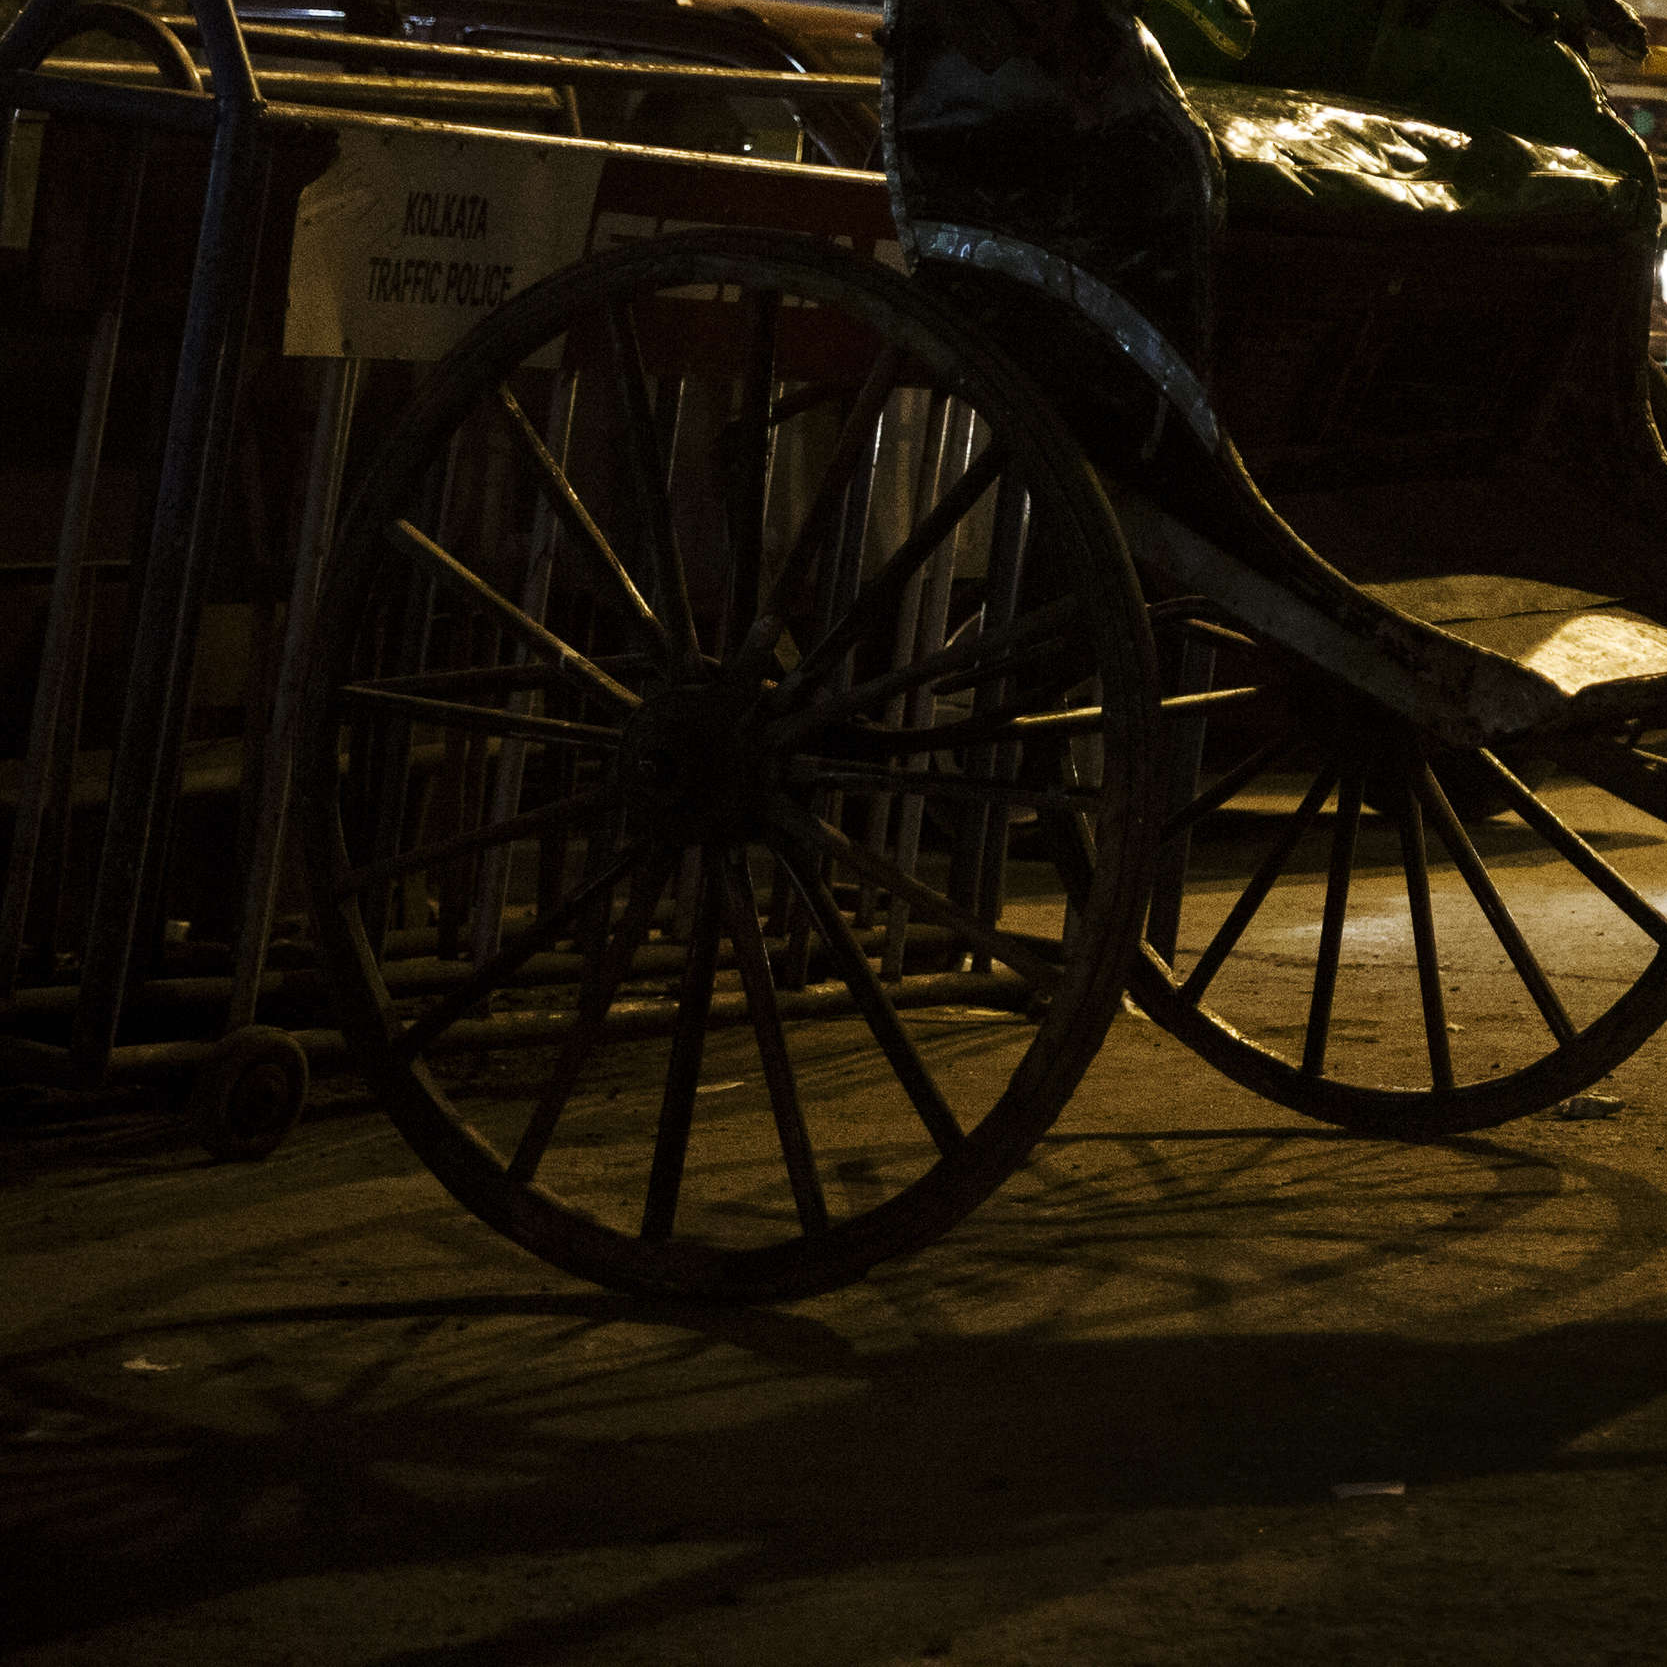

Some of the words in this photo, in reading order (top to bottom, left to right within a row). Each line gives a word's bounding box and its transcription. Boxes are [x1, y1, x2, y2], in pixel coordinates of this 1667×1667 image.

[403, 190, 489, 240] KOLKATA
[368, 256, 442, 304] TRAFFIC
[442, 260, 513, 308] POLICE
